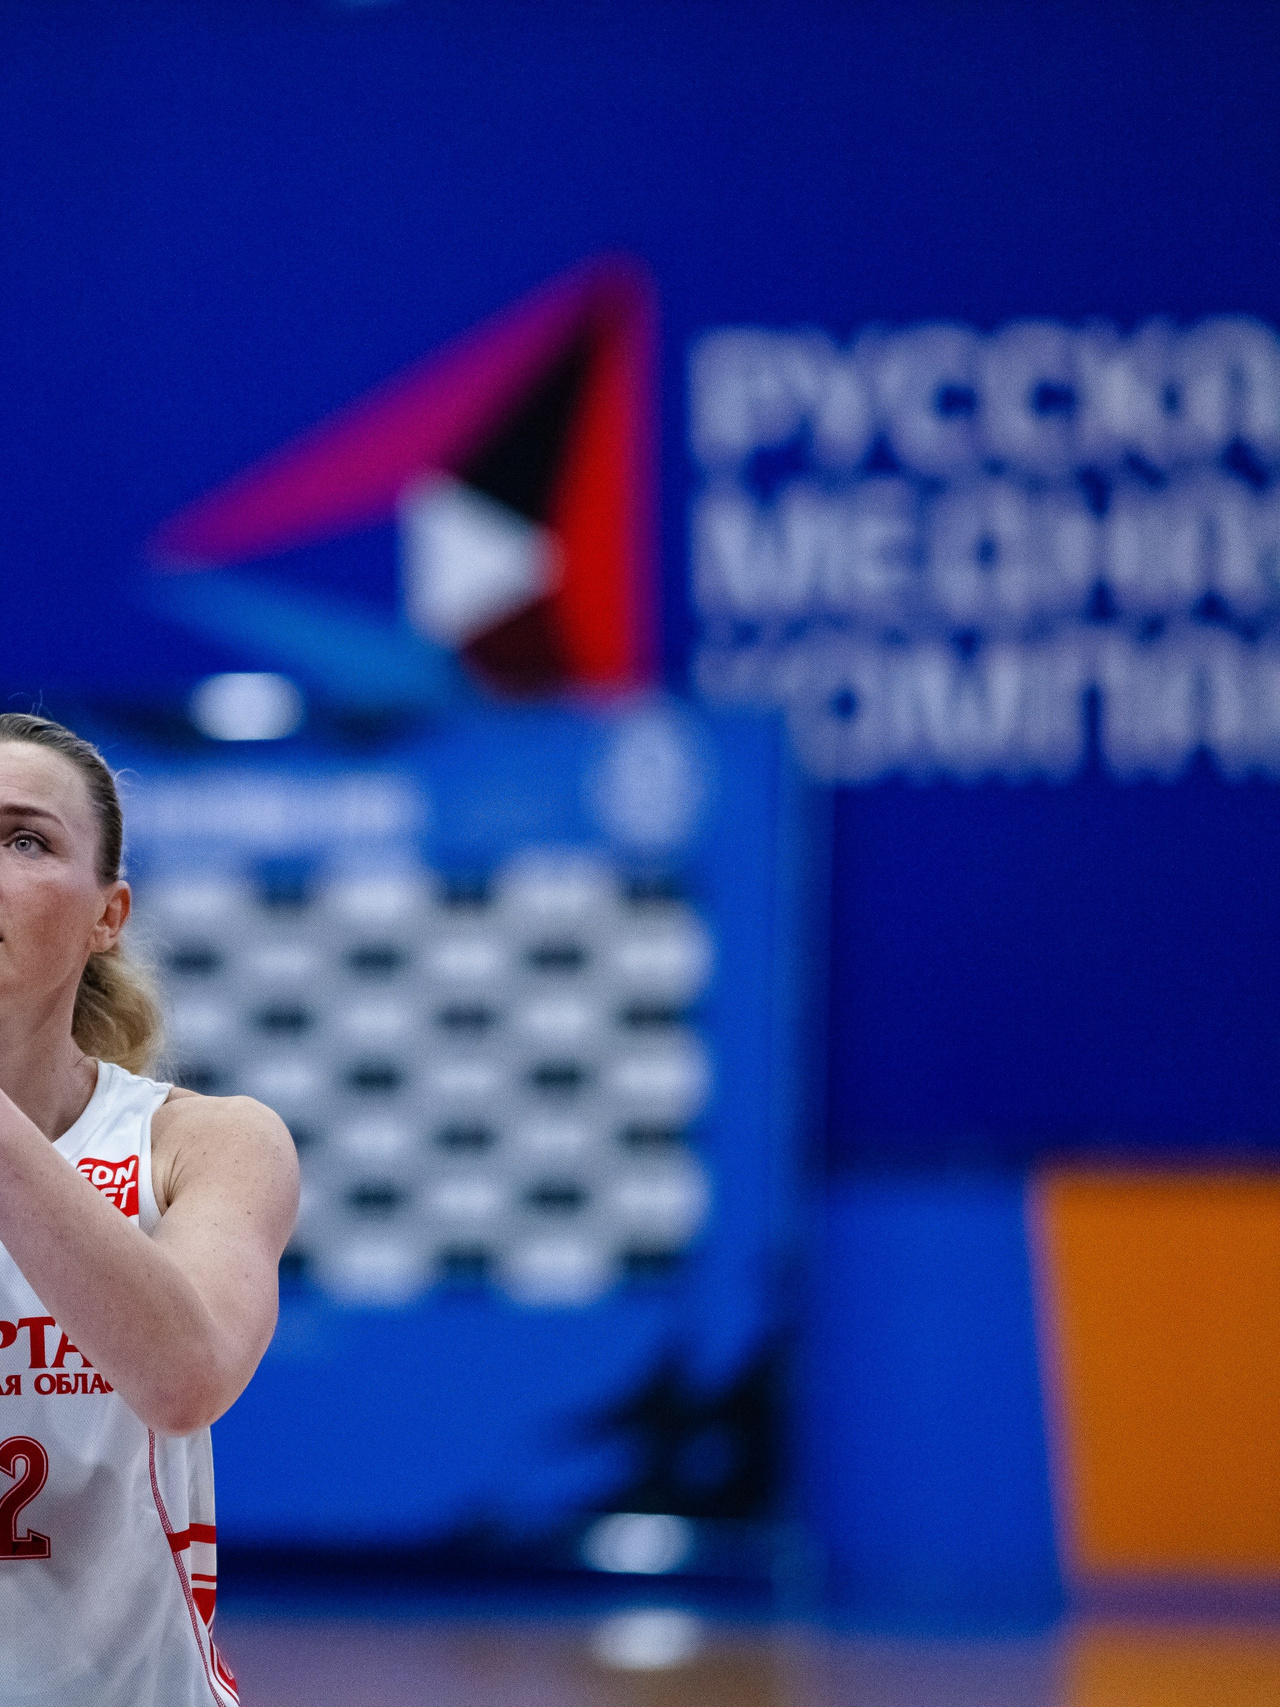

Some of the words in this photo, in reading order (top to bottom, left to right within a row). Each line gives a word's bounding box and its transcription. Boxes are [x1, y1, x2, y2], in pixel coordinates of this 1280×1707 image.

[693, 328, 1280, 464] РУССКА
[693, 486, 1280, 618] МЕДНА
[693, 638, 1280, 778] ОМПА
[77, 1160, 136, 1186] FON
[99, 1180, 137, 1209] ET
